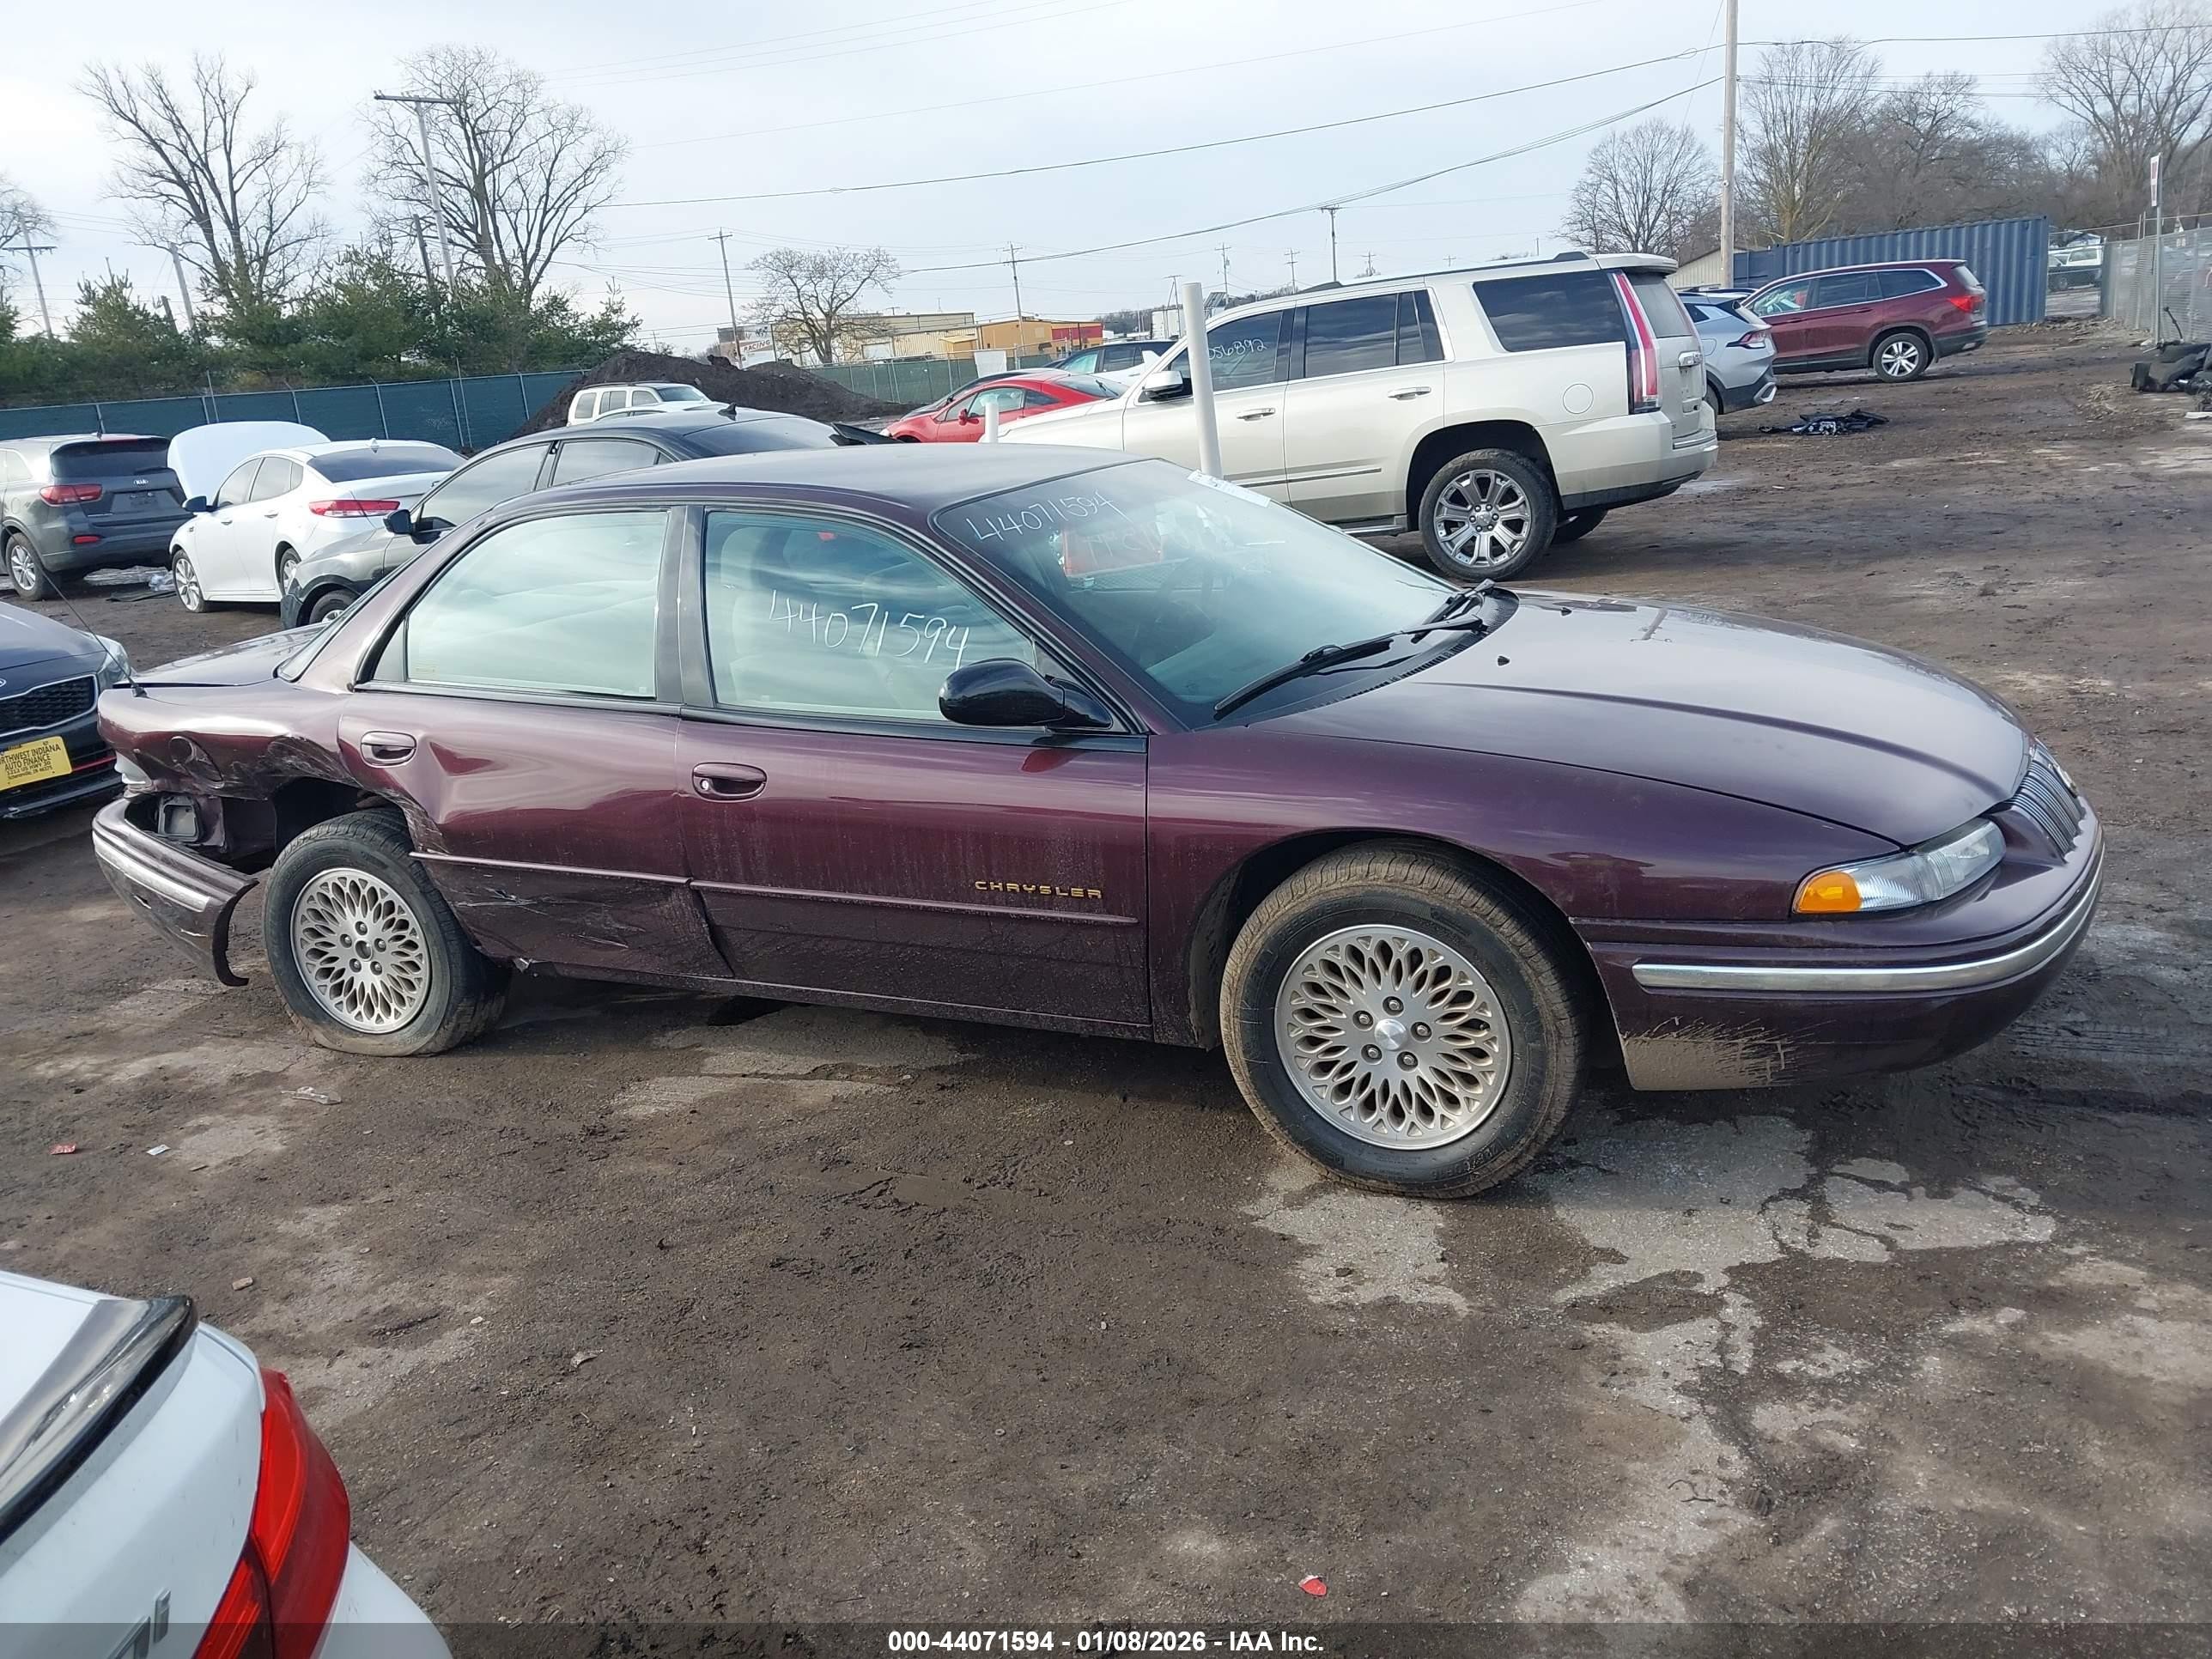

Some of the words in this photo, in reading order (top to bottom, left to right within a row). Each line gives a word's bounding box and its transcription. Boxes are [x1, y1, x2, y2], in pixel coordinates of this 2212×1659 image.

[744, 339, 771, 351] RACING
[966, 489, 1133, 542] 44071594
[769, 589, 970, 671] 44071594
[0, 750, 30, 764] RTHWEST
[31, 744, 61, 757] INDIANA
[5, 760, 22, 771] AUTO
[23, 753, 52, 766] FINANCE
[975, 880, 1103, 899] CHRYSLER
